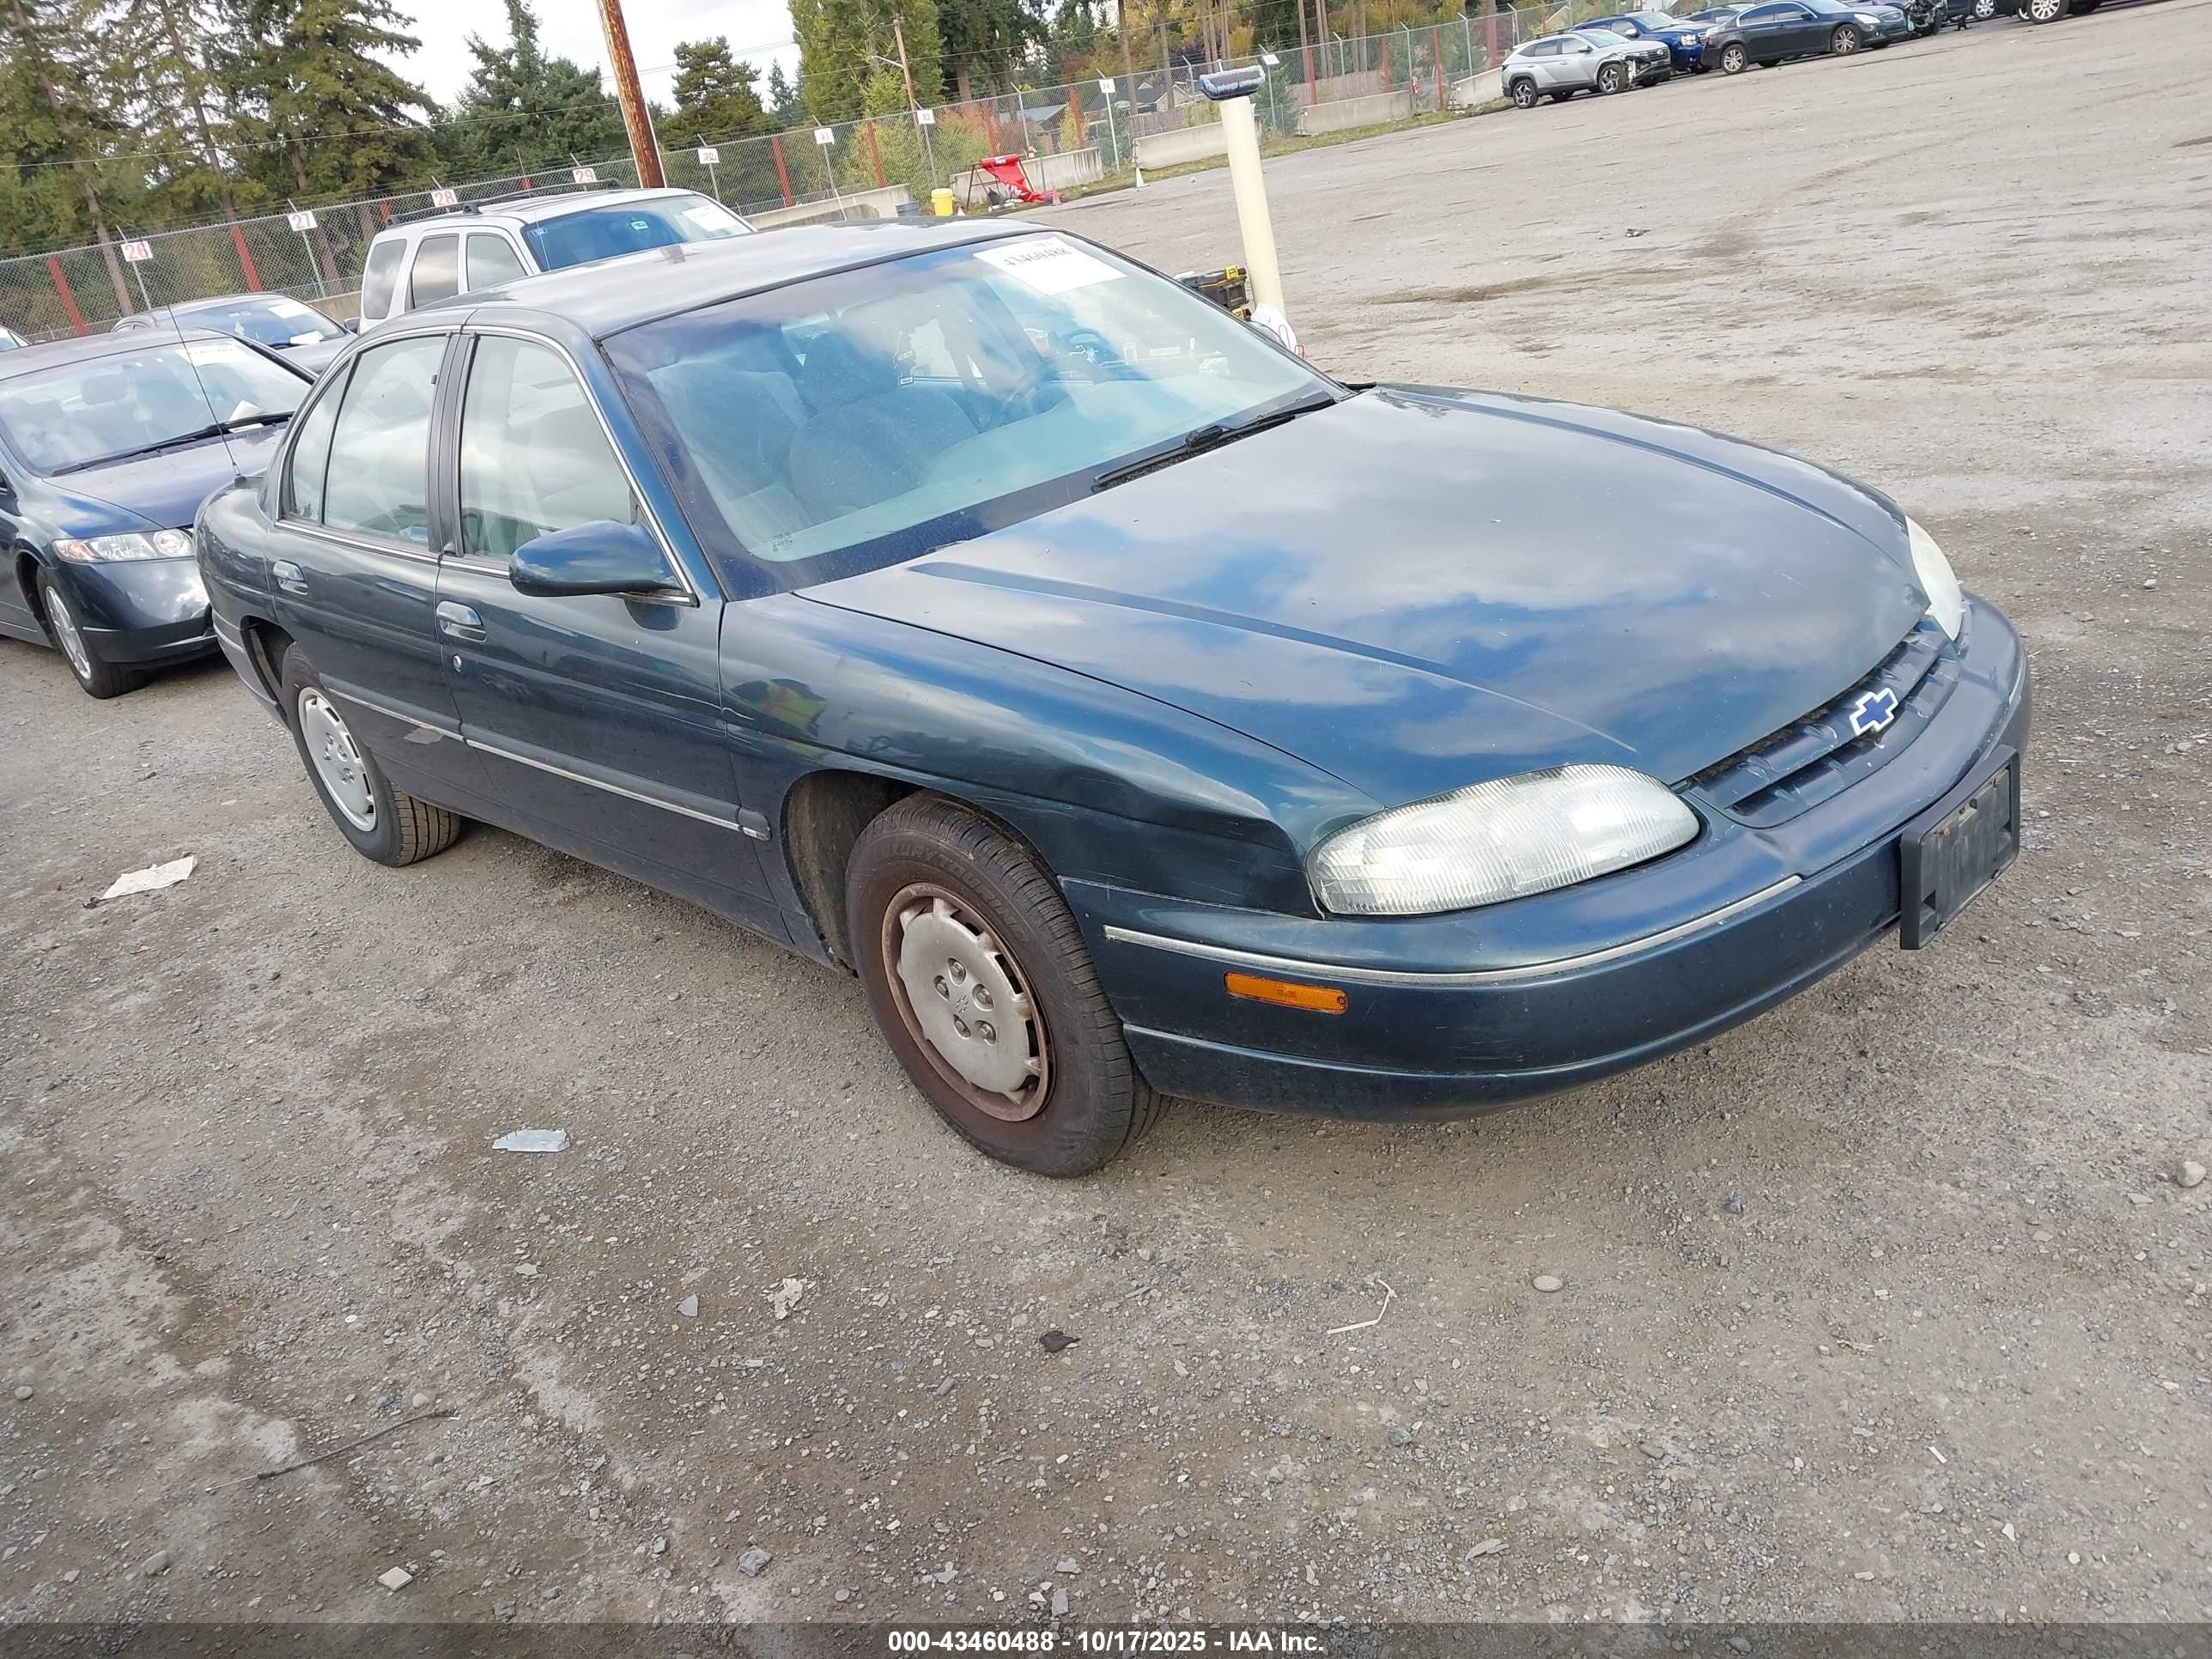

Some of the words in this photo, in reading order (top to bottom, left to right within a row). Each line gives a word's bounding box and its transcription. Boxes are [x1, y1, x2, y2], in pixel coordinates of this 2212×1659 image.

[575, 169, 594, 182] 29
[434, 191, 455, 205] 28
[292, 213, 310, 229] 27
